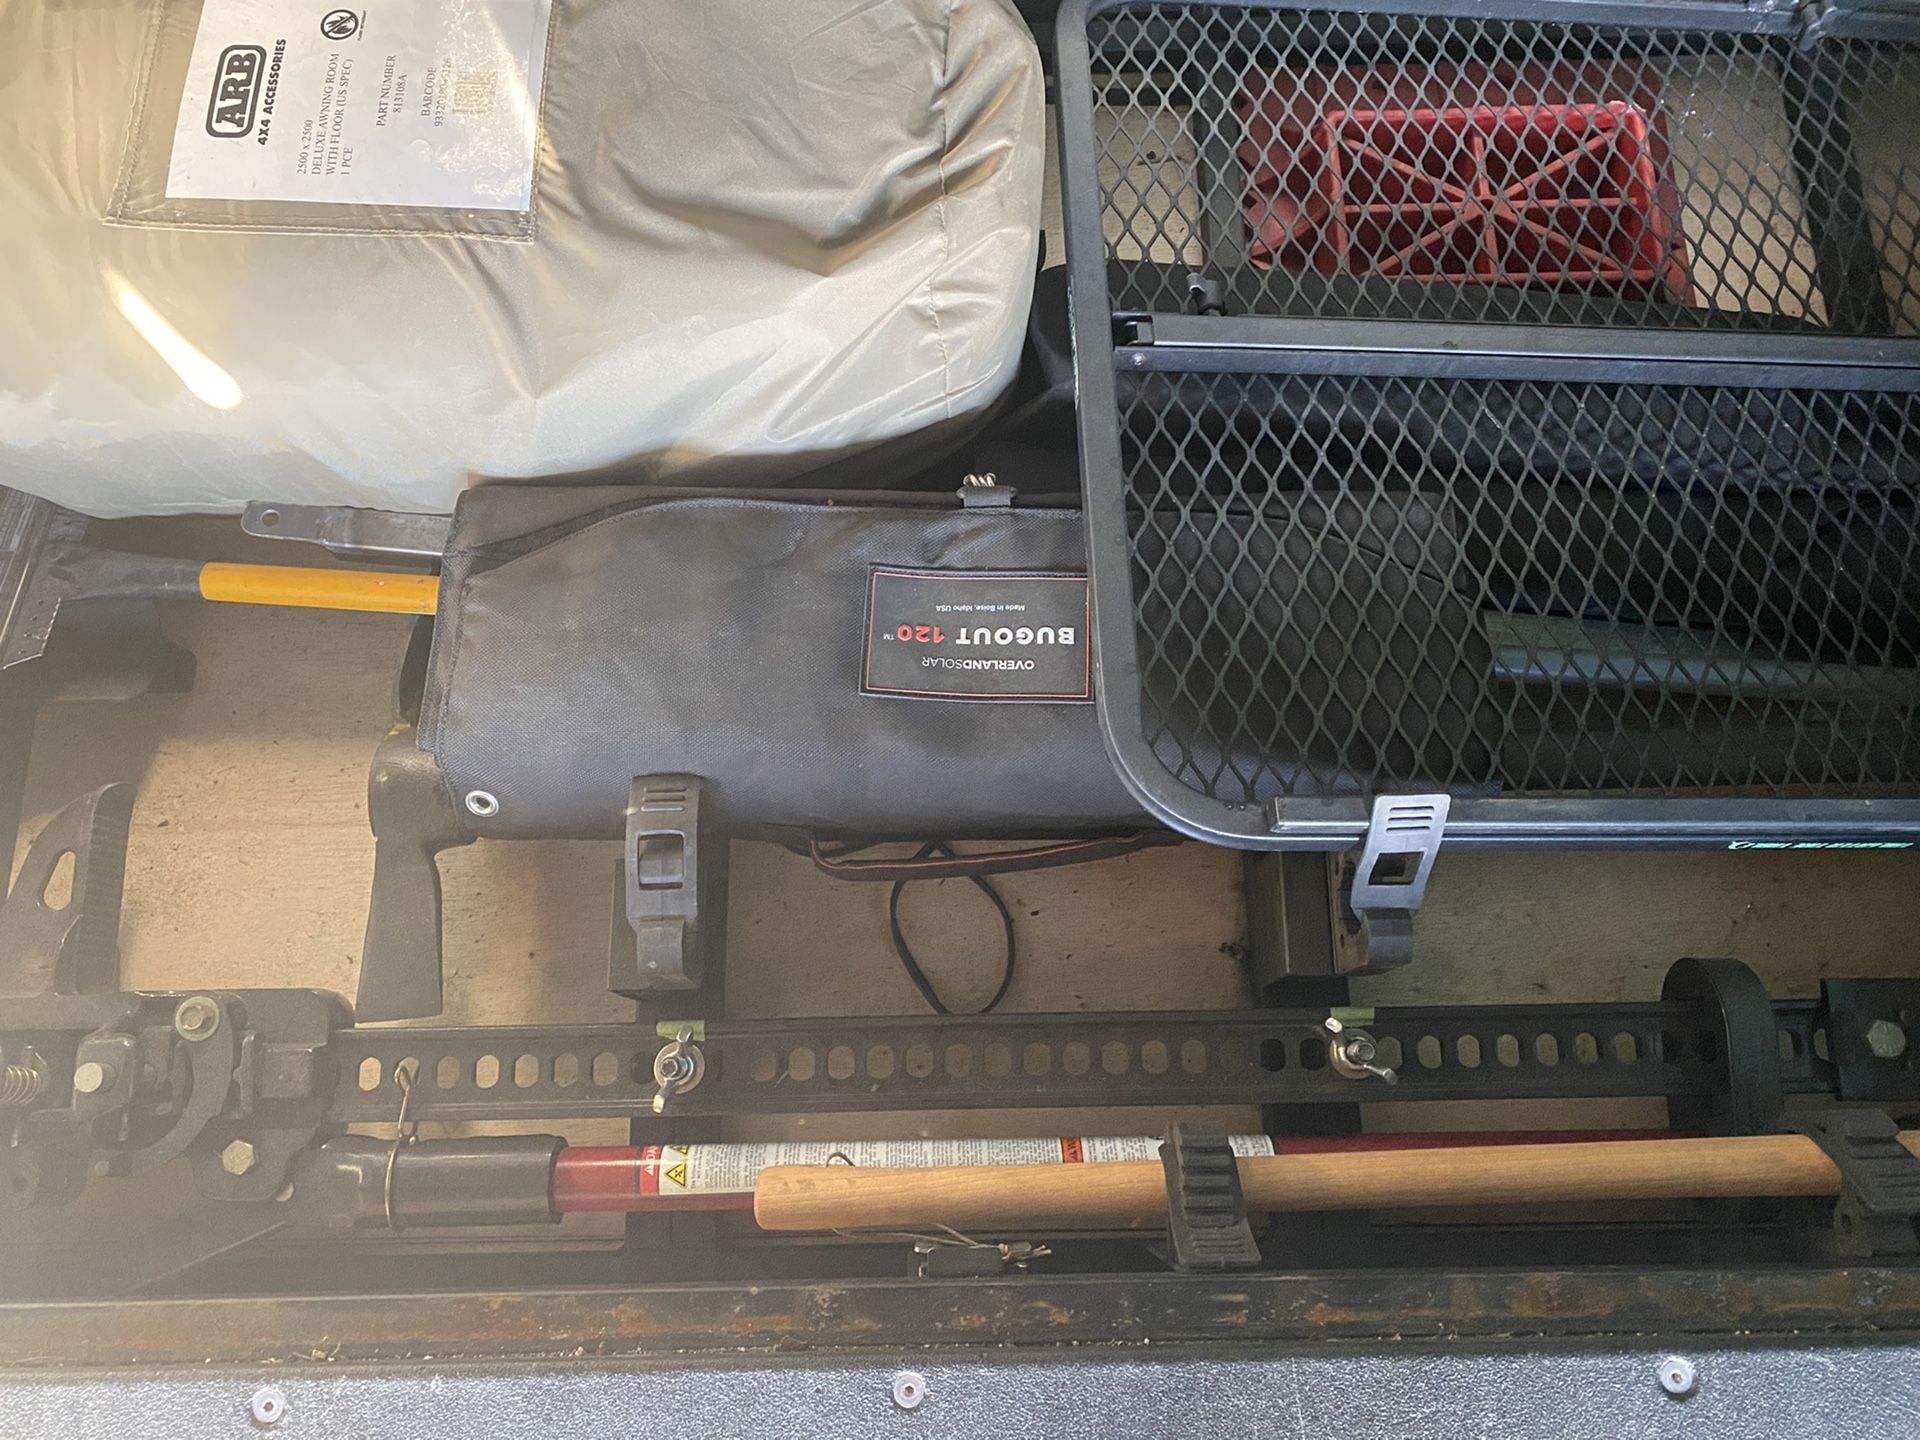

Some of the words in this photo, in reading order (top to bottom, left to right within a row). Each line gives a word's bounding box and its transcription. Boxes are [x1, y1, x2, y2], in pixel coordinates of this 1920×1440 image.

[263, 39, 286, 114] ACCESSORIES
[325, 53, 339, 83] ROOM
[340, 59, 354, 83] SPEC)
[380, 55, 396, 99] NUMBER
[215, 53, 257, 127] ARB
[337, 84, 347, 107] (US
[393, 74, 407, 113] 813108A
[421, 66, 437, 116] BARCODE
[319, 86, 334, 129] AWNING
[376, 101, 389, 126] PART
[257, 119, 271, 145] 4X4
[302, 119, 314, 141] 2500
[330, 108, 344, 144] FLOOR
[297, 152, 309, 174] 2500
[311, 131, 326, 175] DELUXE
[326, 147, 339, 175] WITH
[342, 147, 353, 168] PCE
[936, 604, 951, 612] USA
[953, 604, 973, 612] Idaho
[1005, 604, 1025, 612] Made
[955, 627, 1075, 645] BUGOUT
